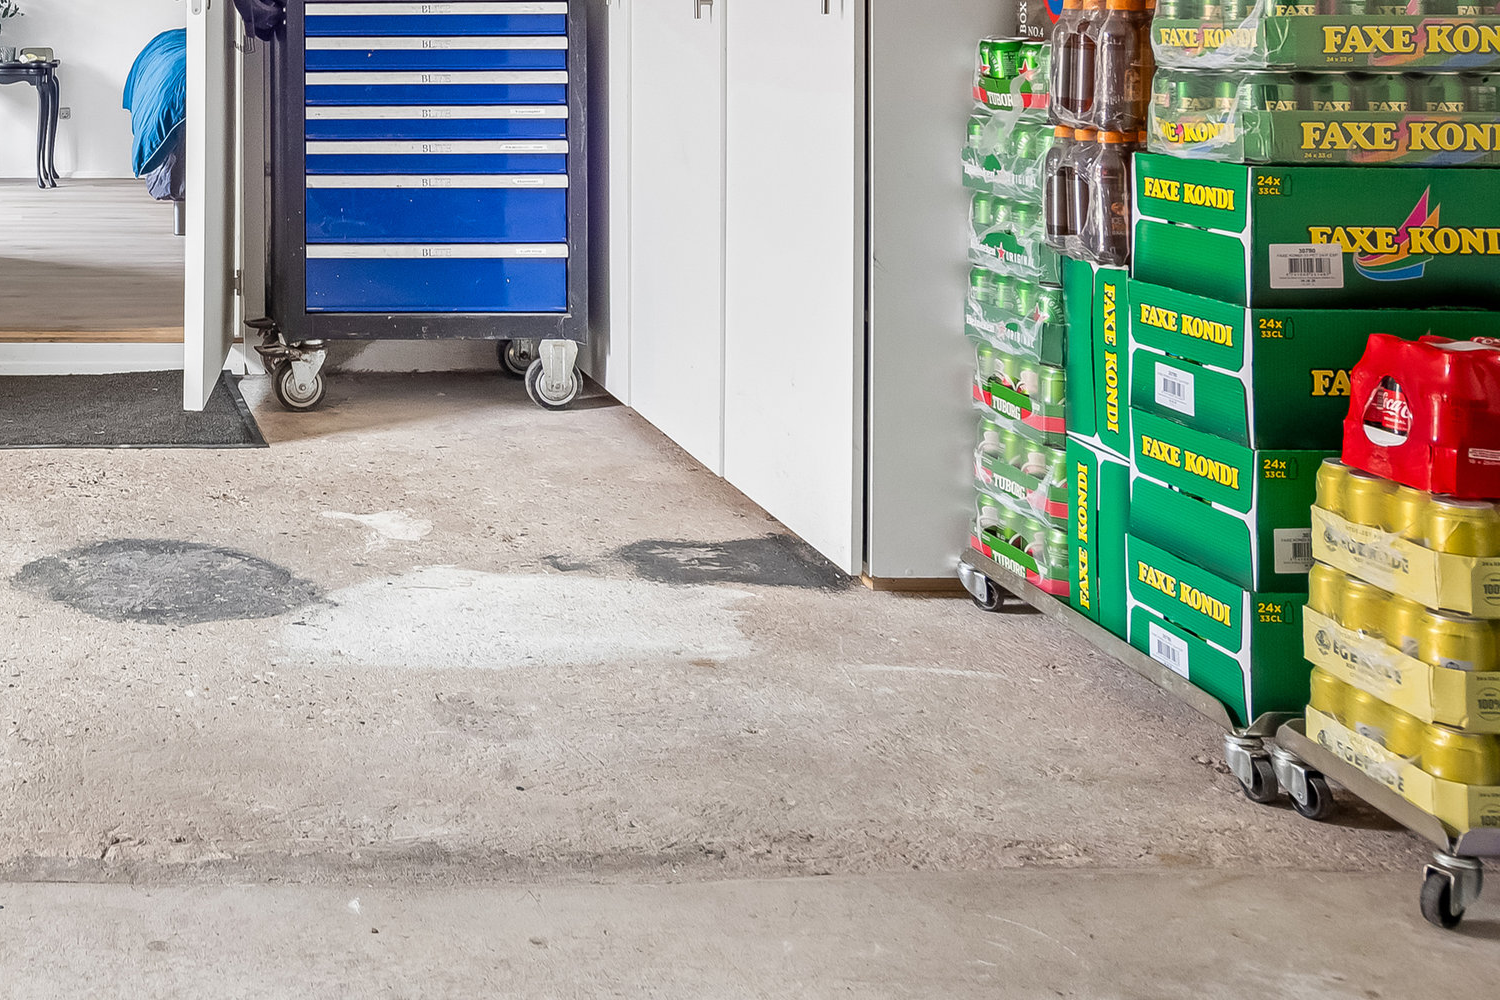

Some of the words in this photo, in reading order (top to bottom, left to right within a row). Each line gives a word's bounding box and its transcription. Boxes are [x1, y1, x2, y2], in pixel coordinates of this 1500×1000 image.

[1019, 1, 1028, 34] BOX
[1027, 26, 1045, 38] NO.4
[1159, 28, 1199, 48] FAXE
[1322, 26, 1416, 54] FAXE
[987, 91, 1020, 107] TUBOR
[1300, 122, 1397, 150] FAXE
[1408, 122, 1500, 151] KON
[1143, 177, 1181, 202] FAXE
[1183, 183, 1235, 211] KONDI
[1257, 175, 1281, 186] 24x
[1257, 187, 1281, 195] 33CL
[1308, 226, 1398, 254] FAXE
[1104, 282, 1117, 347] FAXE
[1140, 303, 1178, 332] FAXE
[1181, 313, 1234, 348] KONDI
[1259, 318, 1283, 329] 24x
[1260, 330, 1283, 338] 33CL
[1104, 350, 1120, 435] KONDI
[1311, 369, 1352, 396] FA
[991, 396, 1021, 421] TUBORG
[1141, 435, 1181, 468] FAXE
[1184, 450, 1240, 490] KONDI
[1263, 459, 1287, 470] 24x
[1264, 470, 1287, 478] 33CL
[992, 472, 1027, 500] TUBORG
[1077, 461, 1089, 544] KONDI
[991, 550, 1027, 579] TUBORG
[1078, 547, 1090, 610] FAXE
[1137, 560, 1177, 598] FAXE
[1179, 581, 1232, 628] KONDI
[1257, 602, 1282, 613] 24x
[1259, 614, 1283, 623] 33CL
